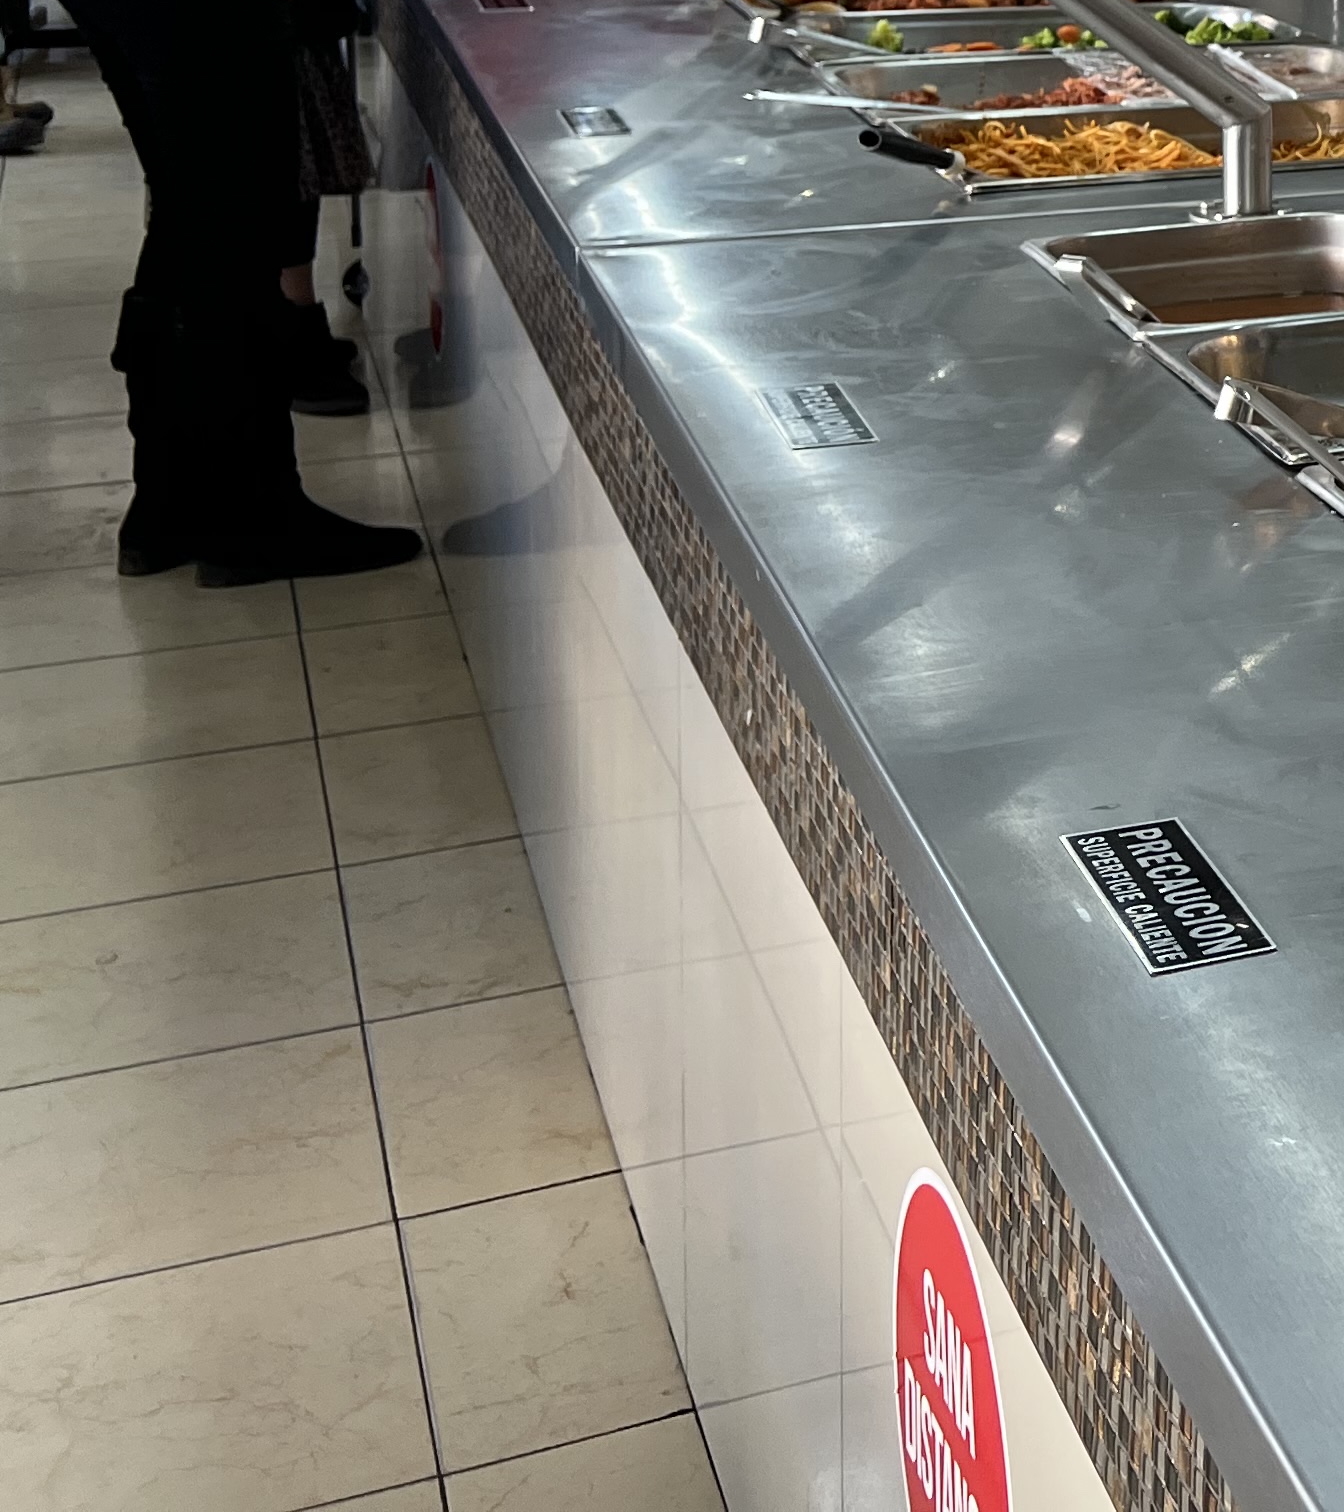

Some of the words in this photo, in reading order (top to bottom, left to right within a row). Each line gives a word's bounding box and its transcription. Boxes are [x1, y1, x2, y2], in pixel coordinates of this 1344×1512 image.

[1076, 836, 1147, 903] SUPERFICIE
[1124, 903, 1188, 964] CALIENTE
[904, 1356, 979, 1512] DISTAN
[923, 1268, 976, 1460] SANA
